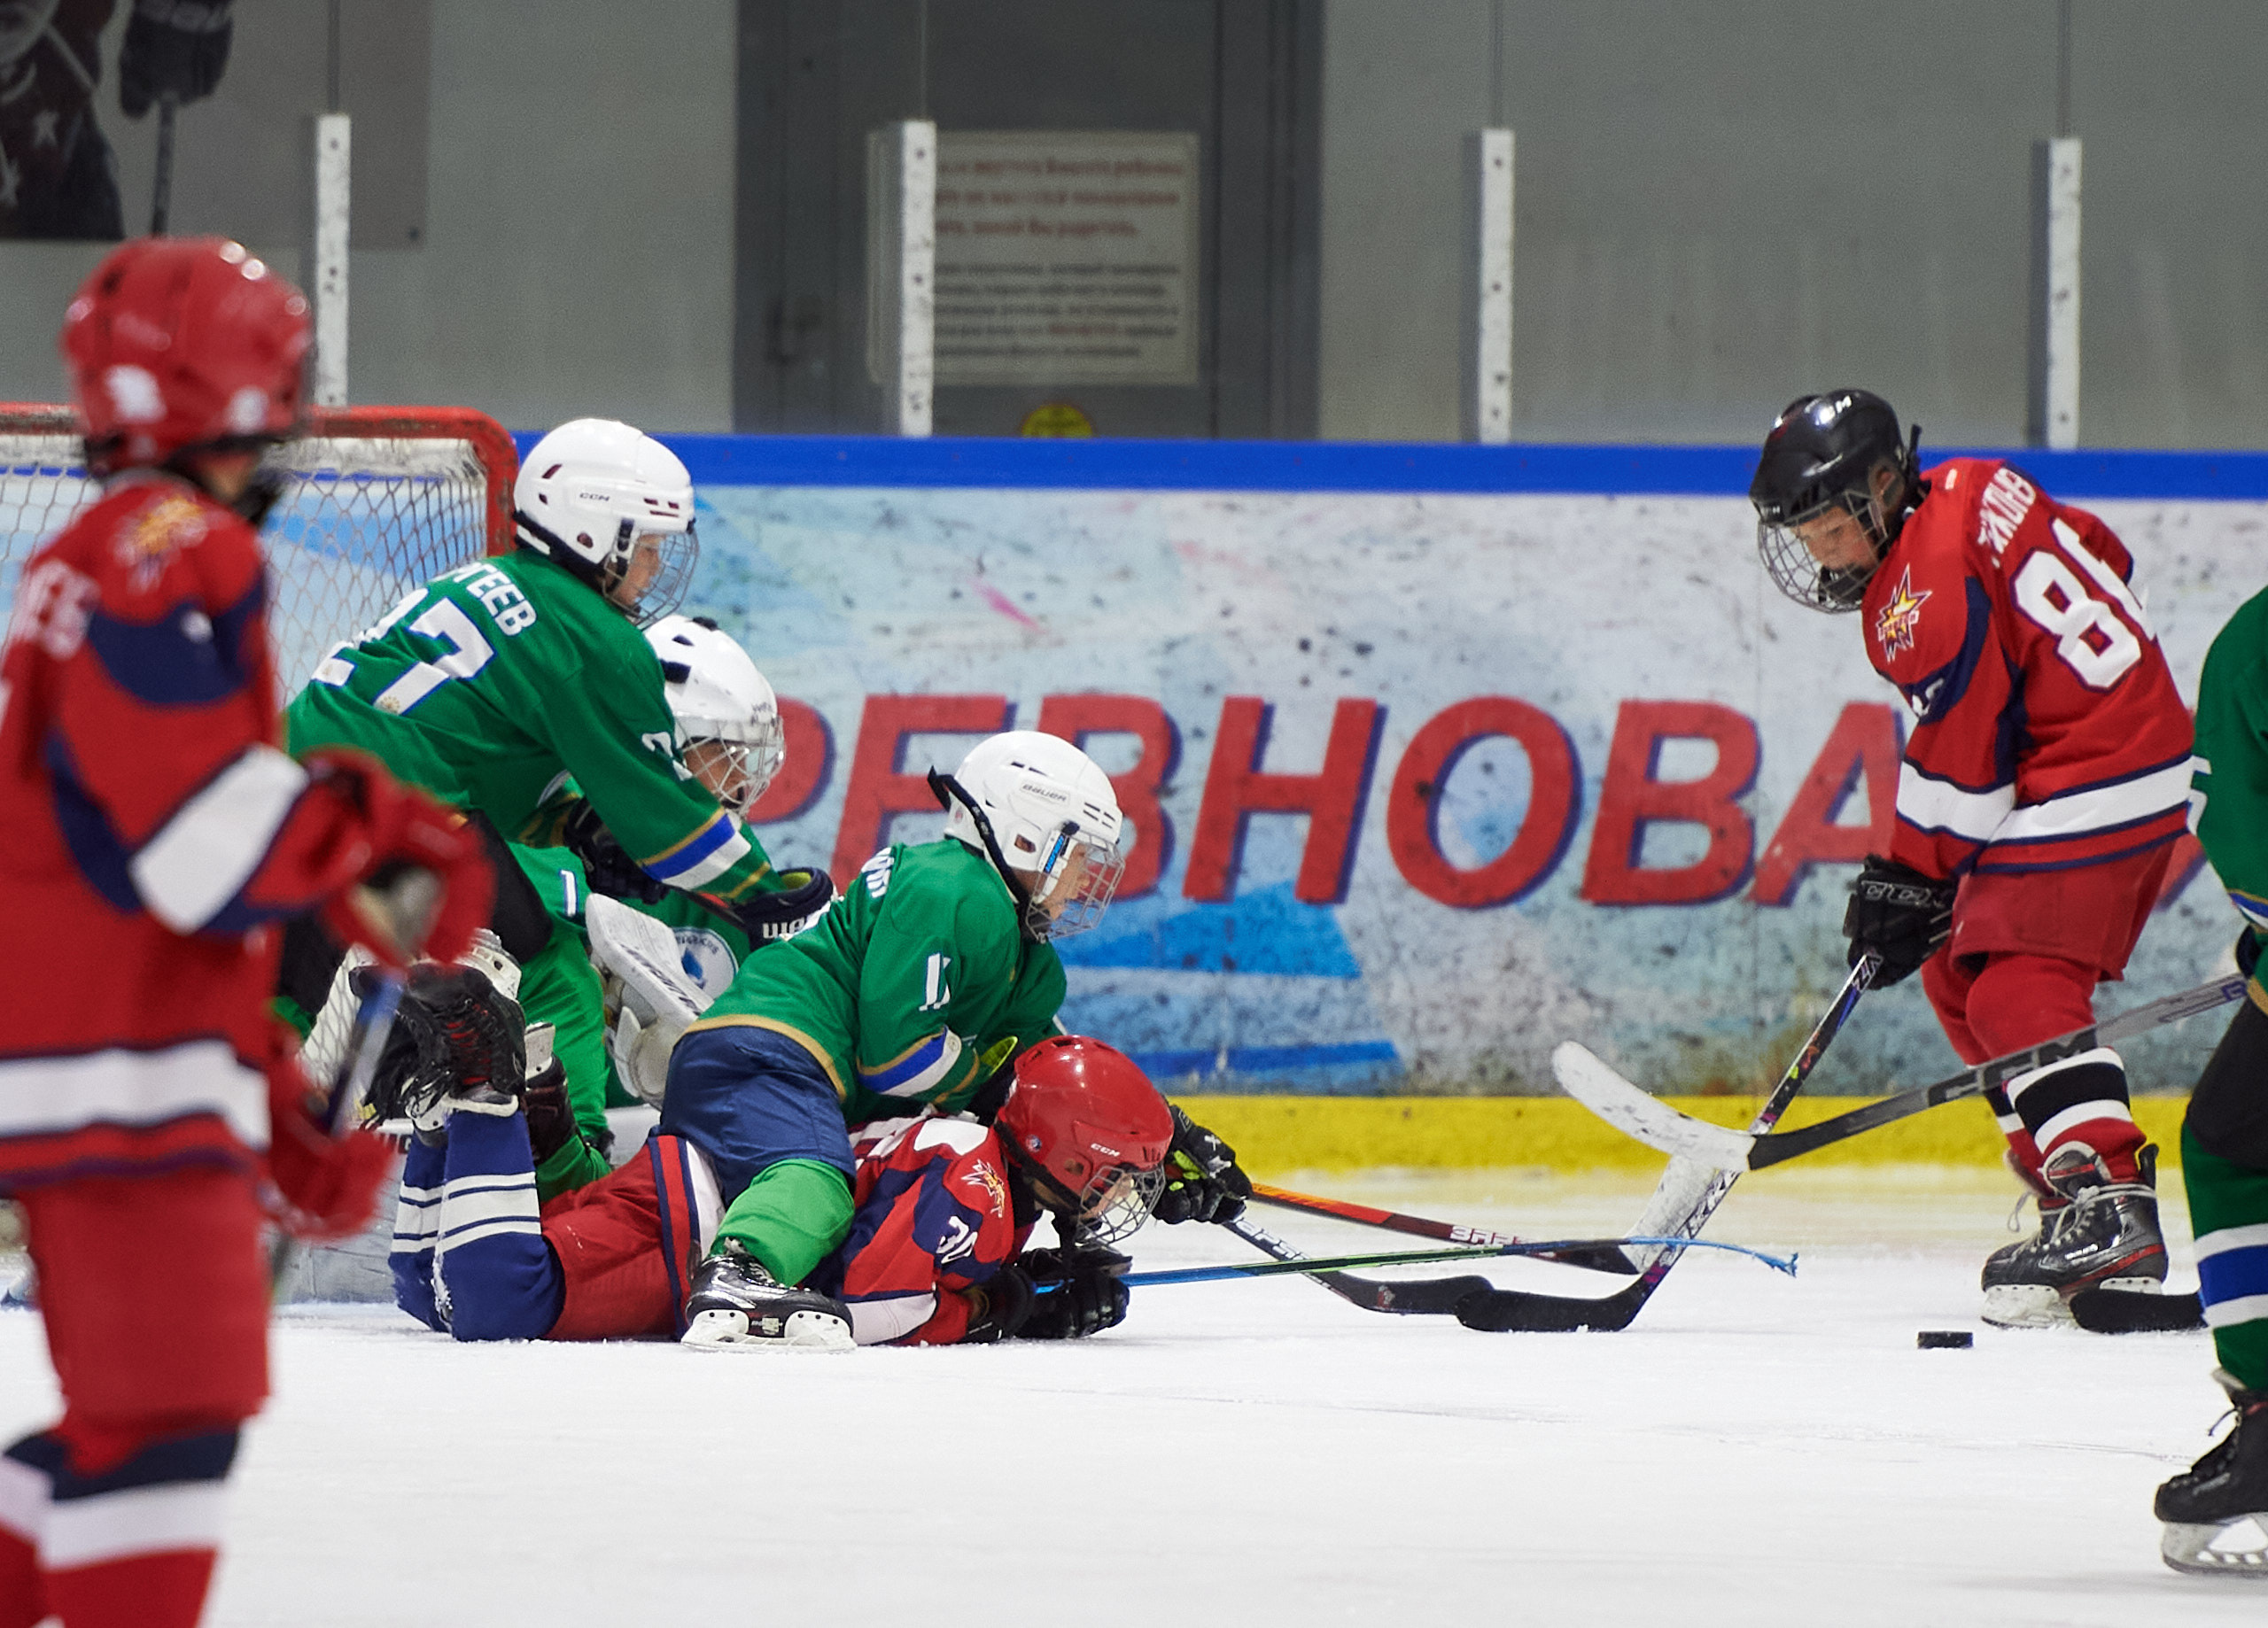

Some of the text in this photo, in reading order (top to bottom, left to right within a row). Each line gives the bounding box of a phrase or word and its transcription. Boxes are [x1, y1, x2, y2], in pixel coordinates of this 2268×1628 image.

[579, 492, 610, 502] CCM
[1021, 783, 1068, 802] BAUER
[1091, 1143, 1121, 1157] CCM
